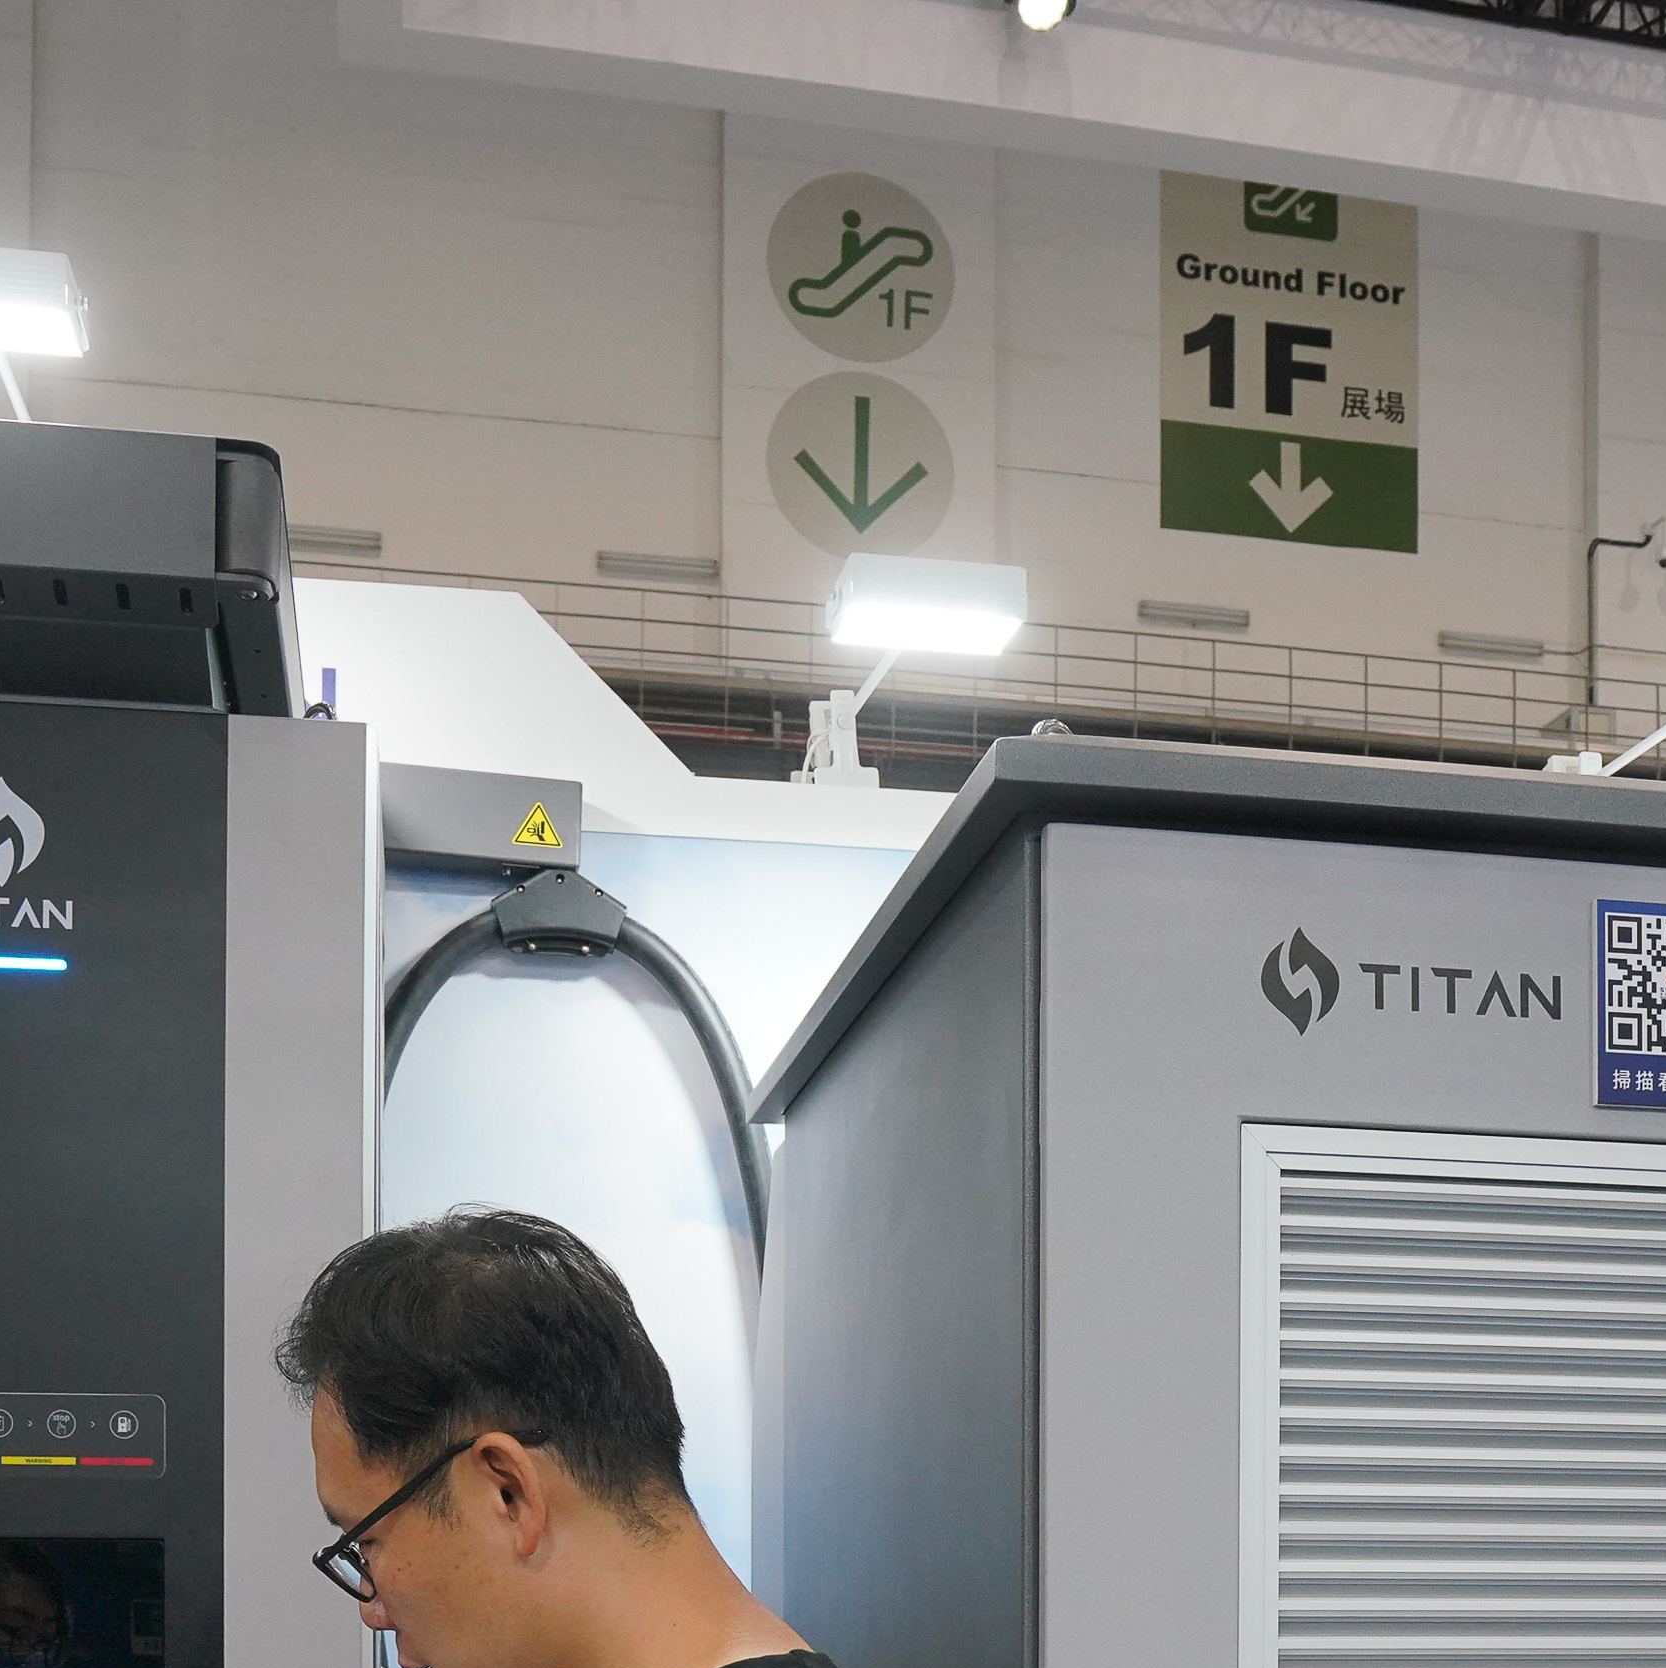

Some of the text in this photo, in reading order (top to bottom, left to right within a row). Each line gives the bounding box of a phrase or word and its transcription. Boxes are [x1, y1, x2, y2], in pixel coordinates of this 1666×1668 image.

[1176, 253, 1407, 305] Ground Floor
[879, 288, 933, 330] 1F
[1183, 312, 1333, 416] 1F
[1341, 385, 1406, 424] 展場
[1358, 962, 1562, 1021] TITAN
[52, 1413, 71, 1423] stop
